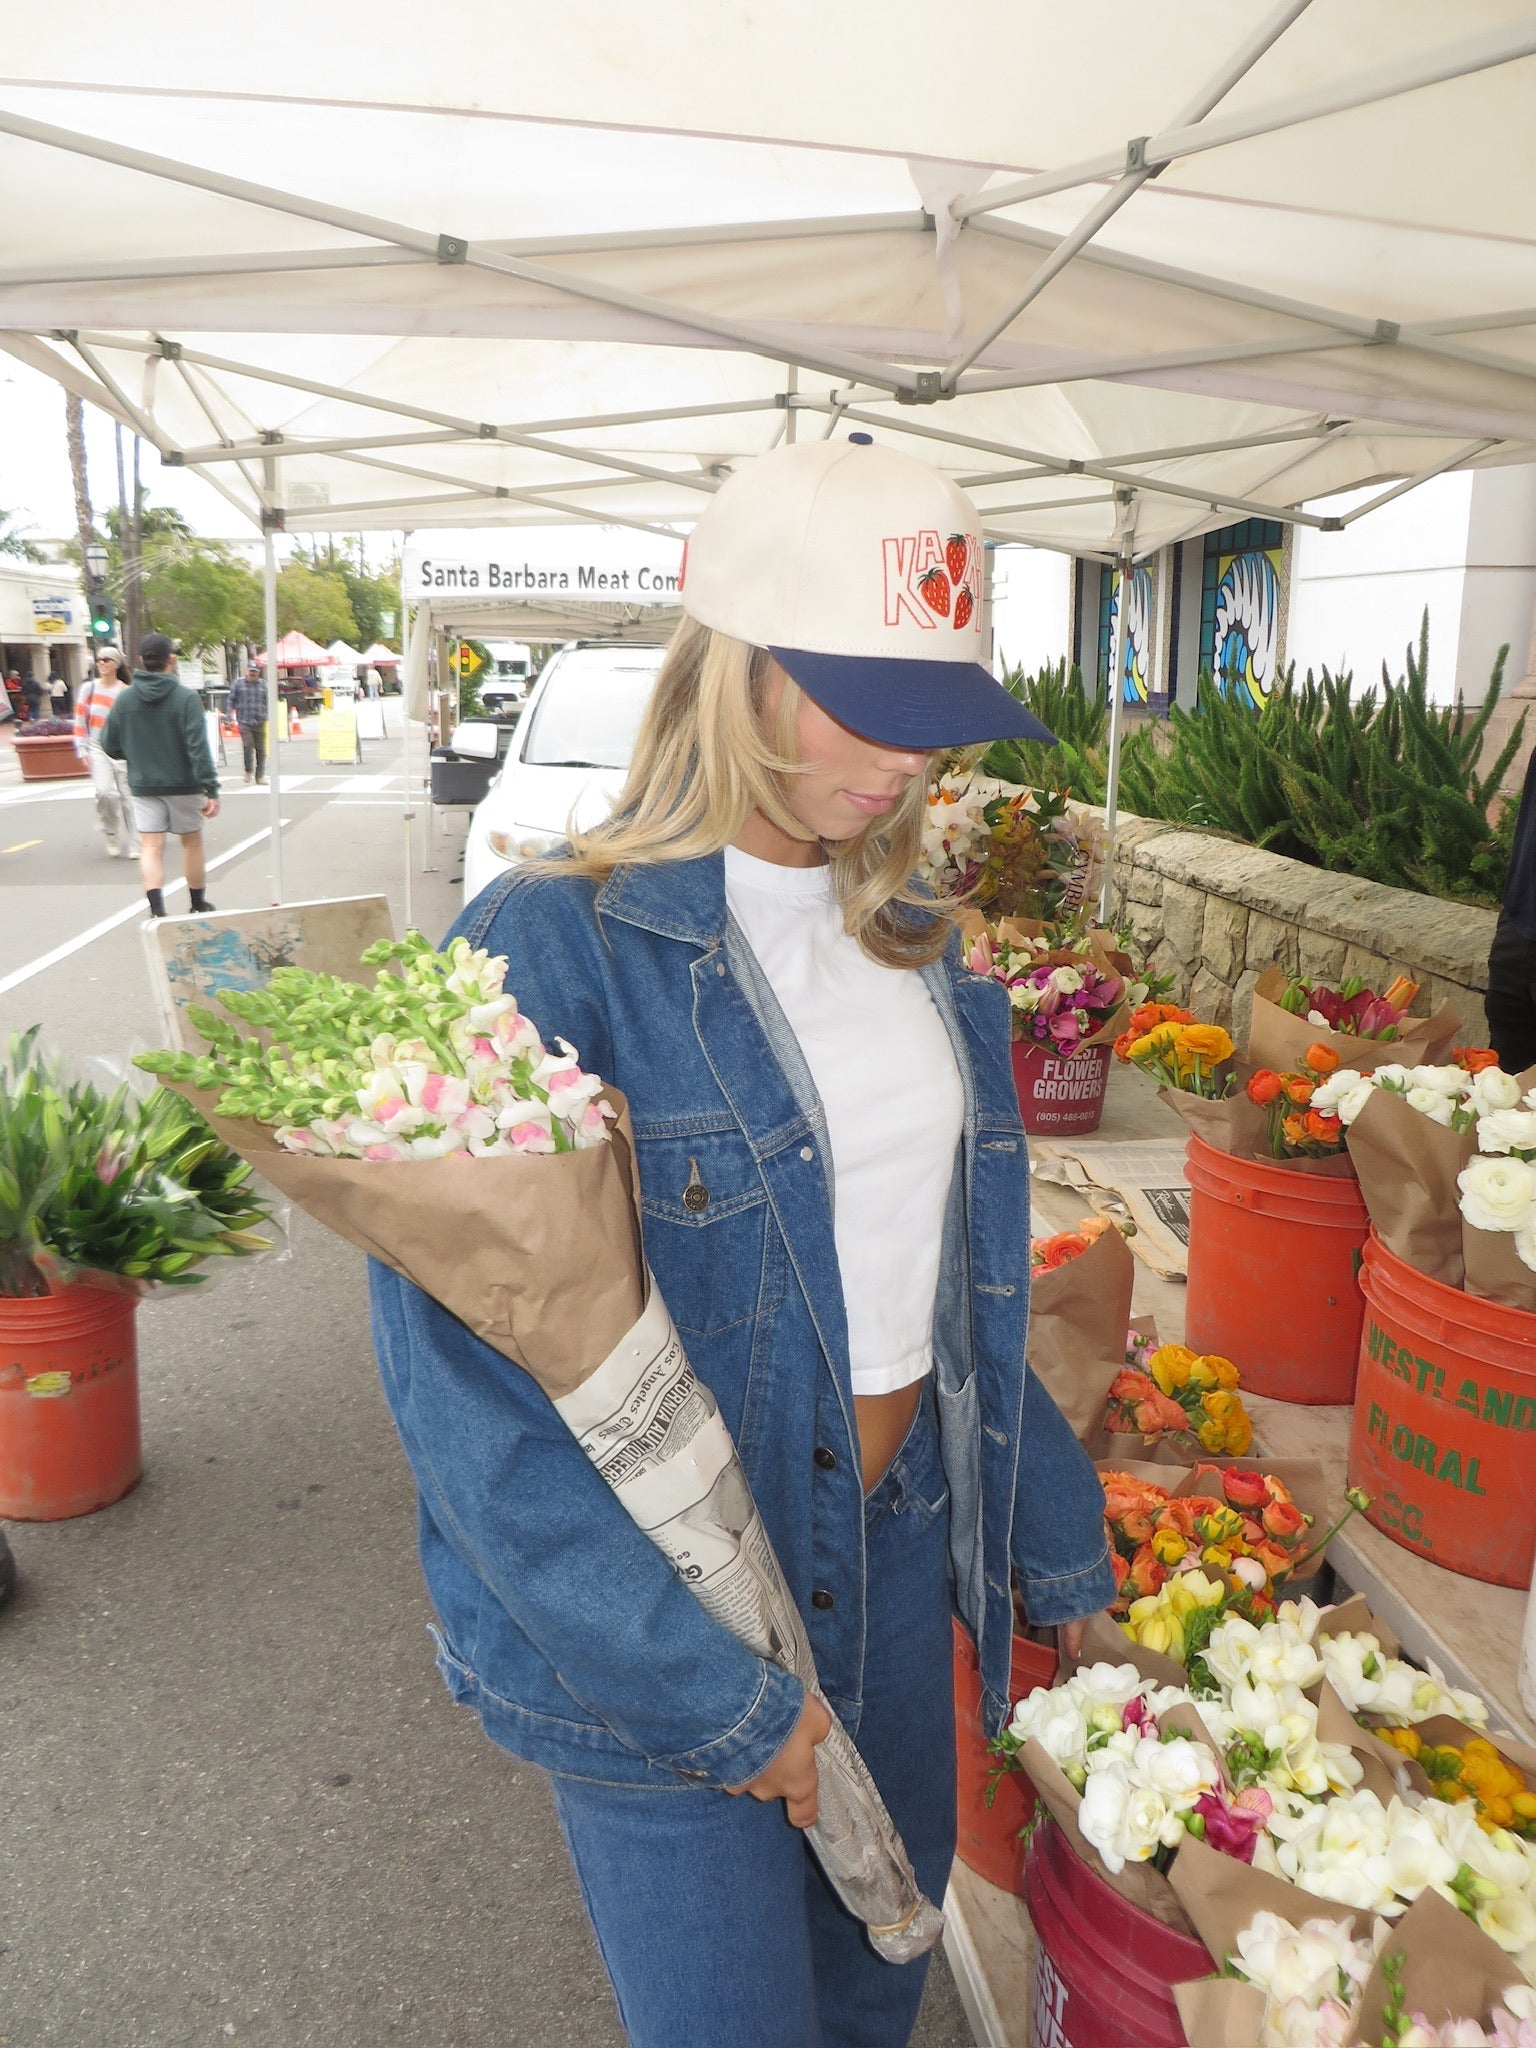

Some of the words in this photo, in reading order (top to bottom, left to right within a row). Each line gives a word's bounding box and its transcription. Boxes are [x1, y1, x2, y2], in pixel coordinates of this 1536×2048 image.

[421, 560, 480, 588] Santa
[488, 563, 570, 590] Barbara
[578, 565, 630, 590] Meat
[637, 567, 681, 592] Com
[1042, 1059, 1103, 1081] FLOWER
[1032, 1078, 1103, 1101] GROWERS
[1036, 1111, 1060, 1124] (805)
[663, 1342, 681, 1366] Los
[1367, 1320, 1536, 1432] WESTLAND
[630, 1365, 667, 1415] Angeles
[598, 1416, 634, 1440] Times
[1366, 1401, 1487, 1496] FLORAL
